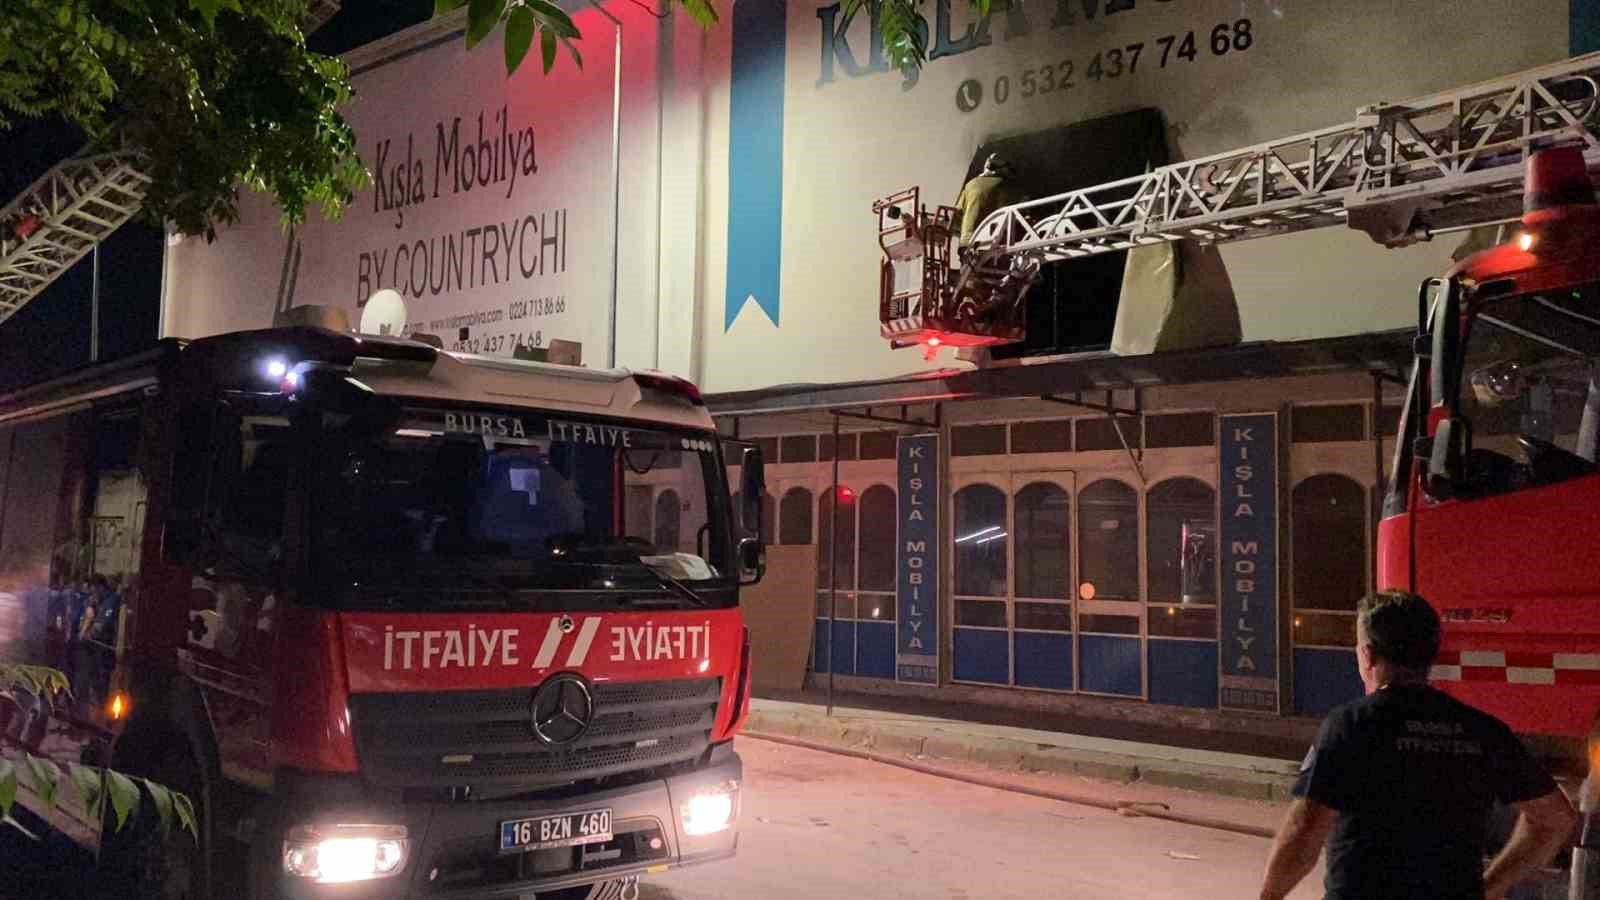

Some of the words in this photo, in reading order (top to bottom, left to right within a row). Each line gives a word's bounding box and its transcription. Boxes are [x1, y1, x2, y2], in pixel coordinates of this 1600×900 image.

[994, 75, 1010, 104] 0
[1020, 60, 1075, 99] 532
[1086, 42, 1145, 81] 437
[1157, 31, 1197, 68] 74
[1211, 18, 1252, 56] 68
[432, 104, 538, 199] Mobilya
[356, 248, 388, 308] BY
[393, 208, 567, 299] COUNTRYCHI
[509, 300, 527, 320] 0224
[528, 299, 543, 318] 713
[484, 335, 504, 352] 437
[528, 330, 542, 349] 68
[445, 413, 525, 437] BURSA
[384, 624, 519, 671] İTFAİYE
[513, 822, 531, 844] 16
[541, 816, 571, 841] BZN
[580, 811, 609, 835] 460
